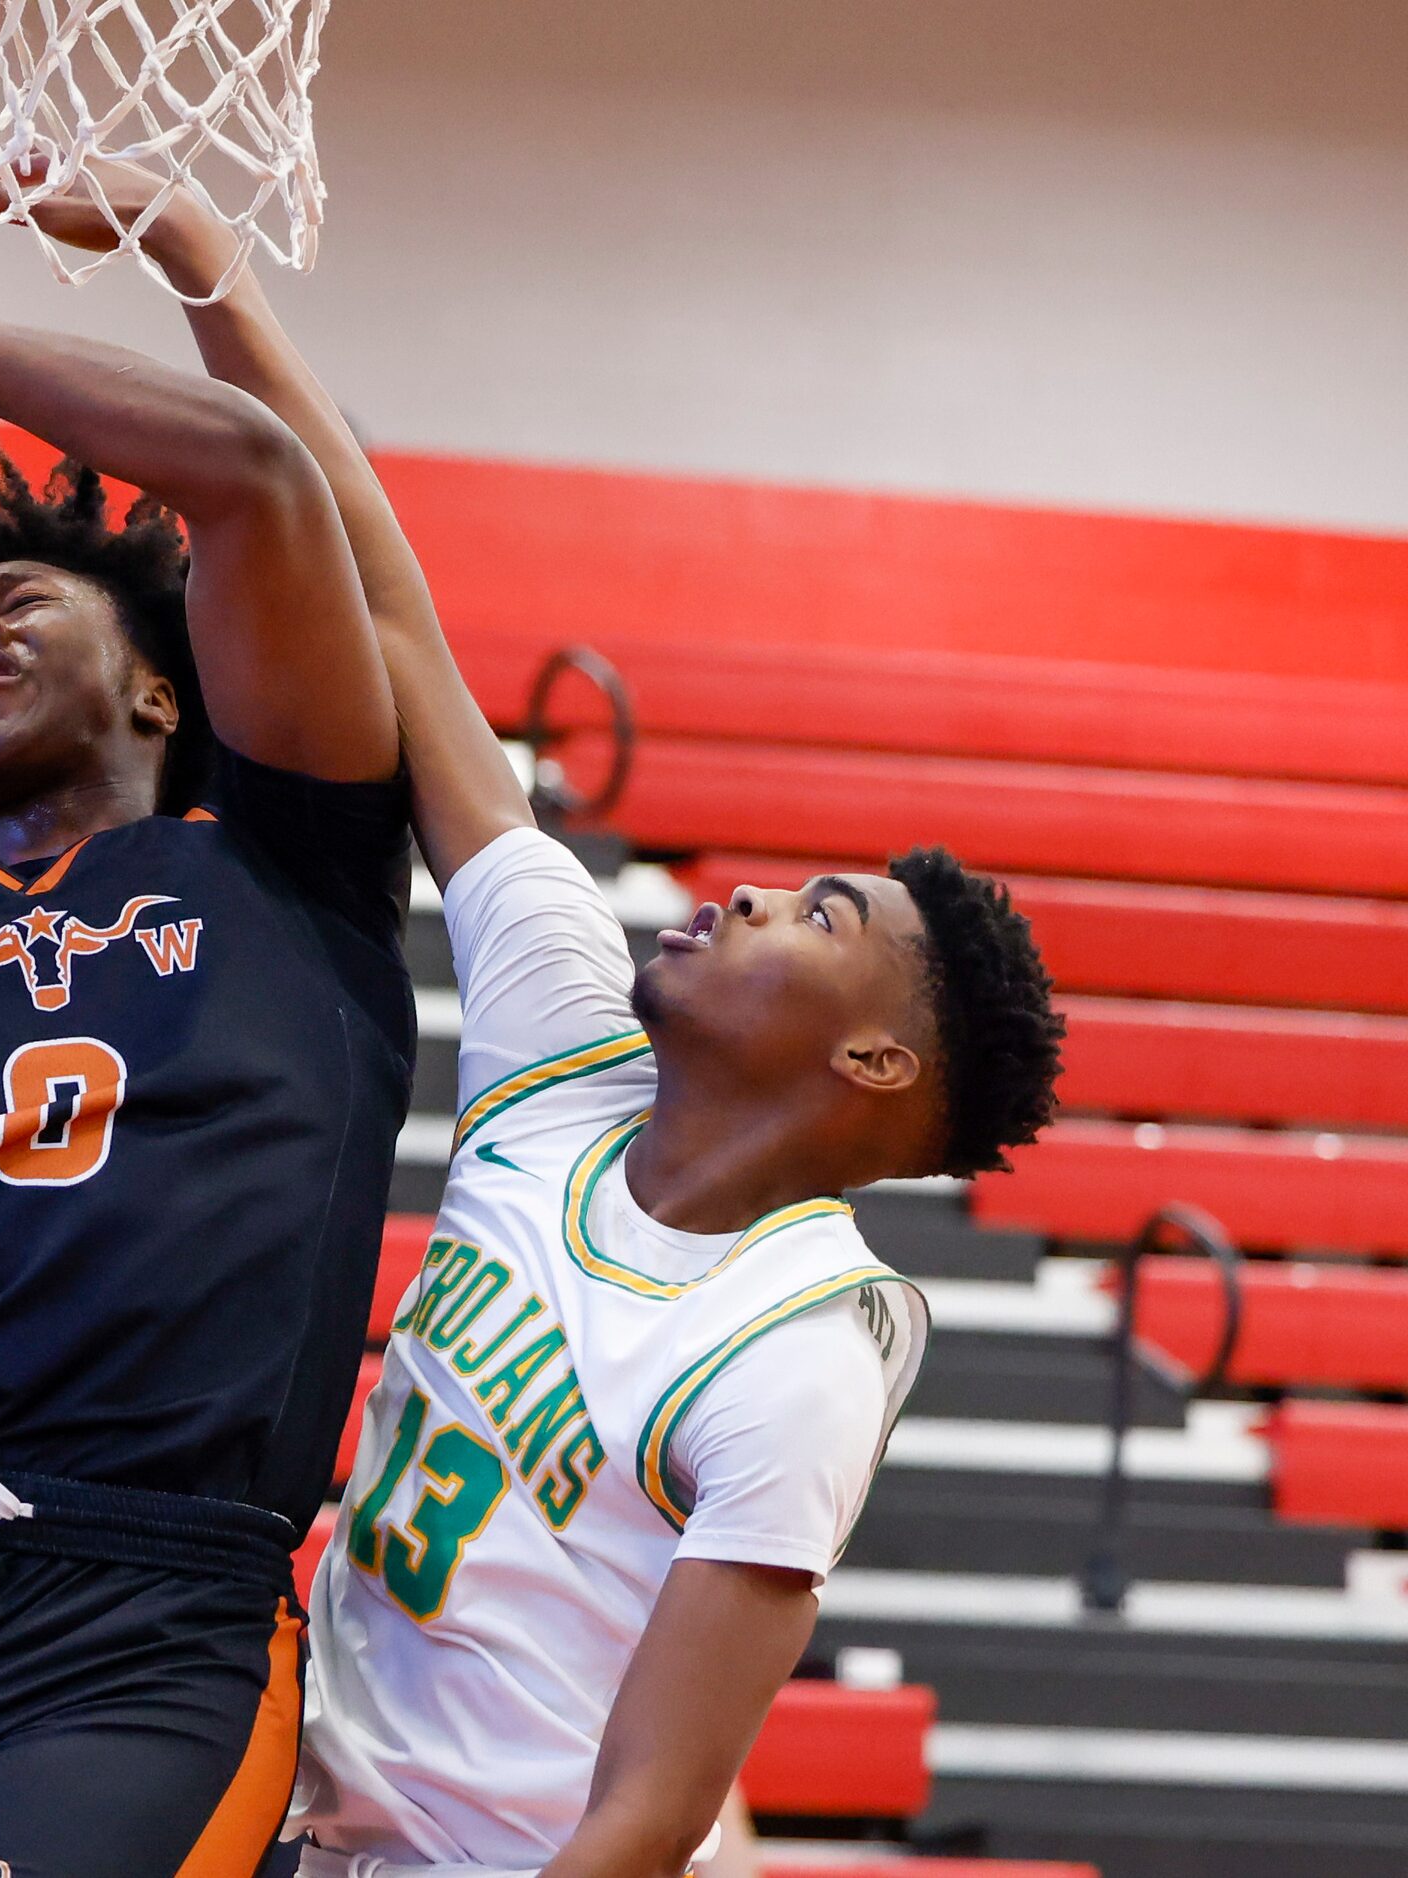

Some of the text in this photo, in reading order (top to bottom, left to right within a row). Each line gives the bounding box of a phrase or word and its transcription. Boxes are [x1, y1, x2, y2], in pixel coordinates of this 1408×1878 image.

[134, 917, 204, 977] W
[390, 1238, 609, 1533] TROJANS
[348, 1387, 511, 1625] 13
